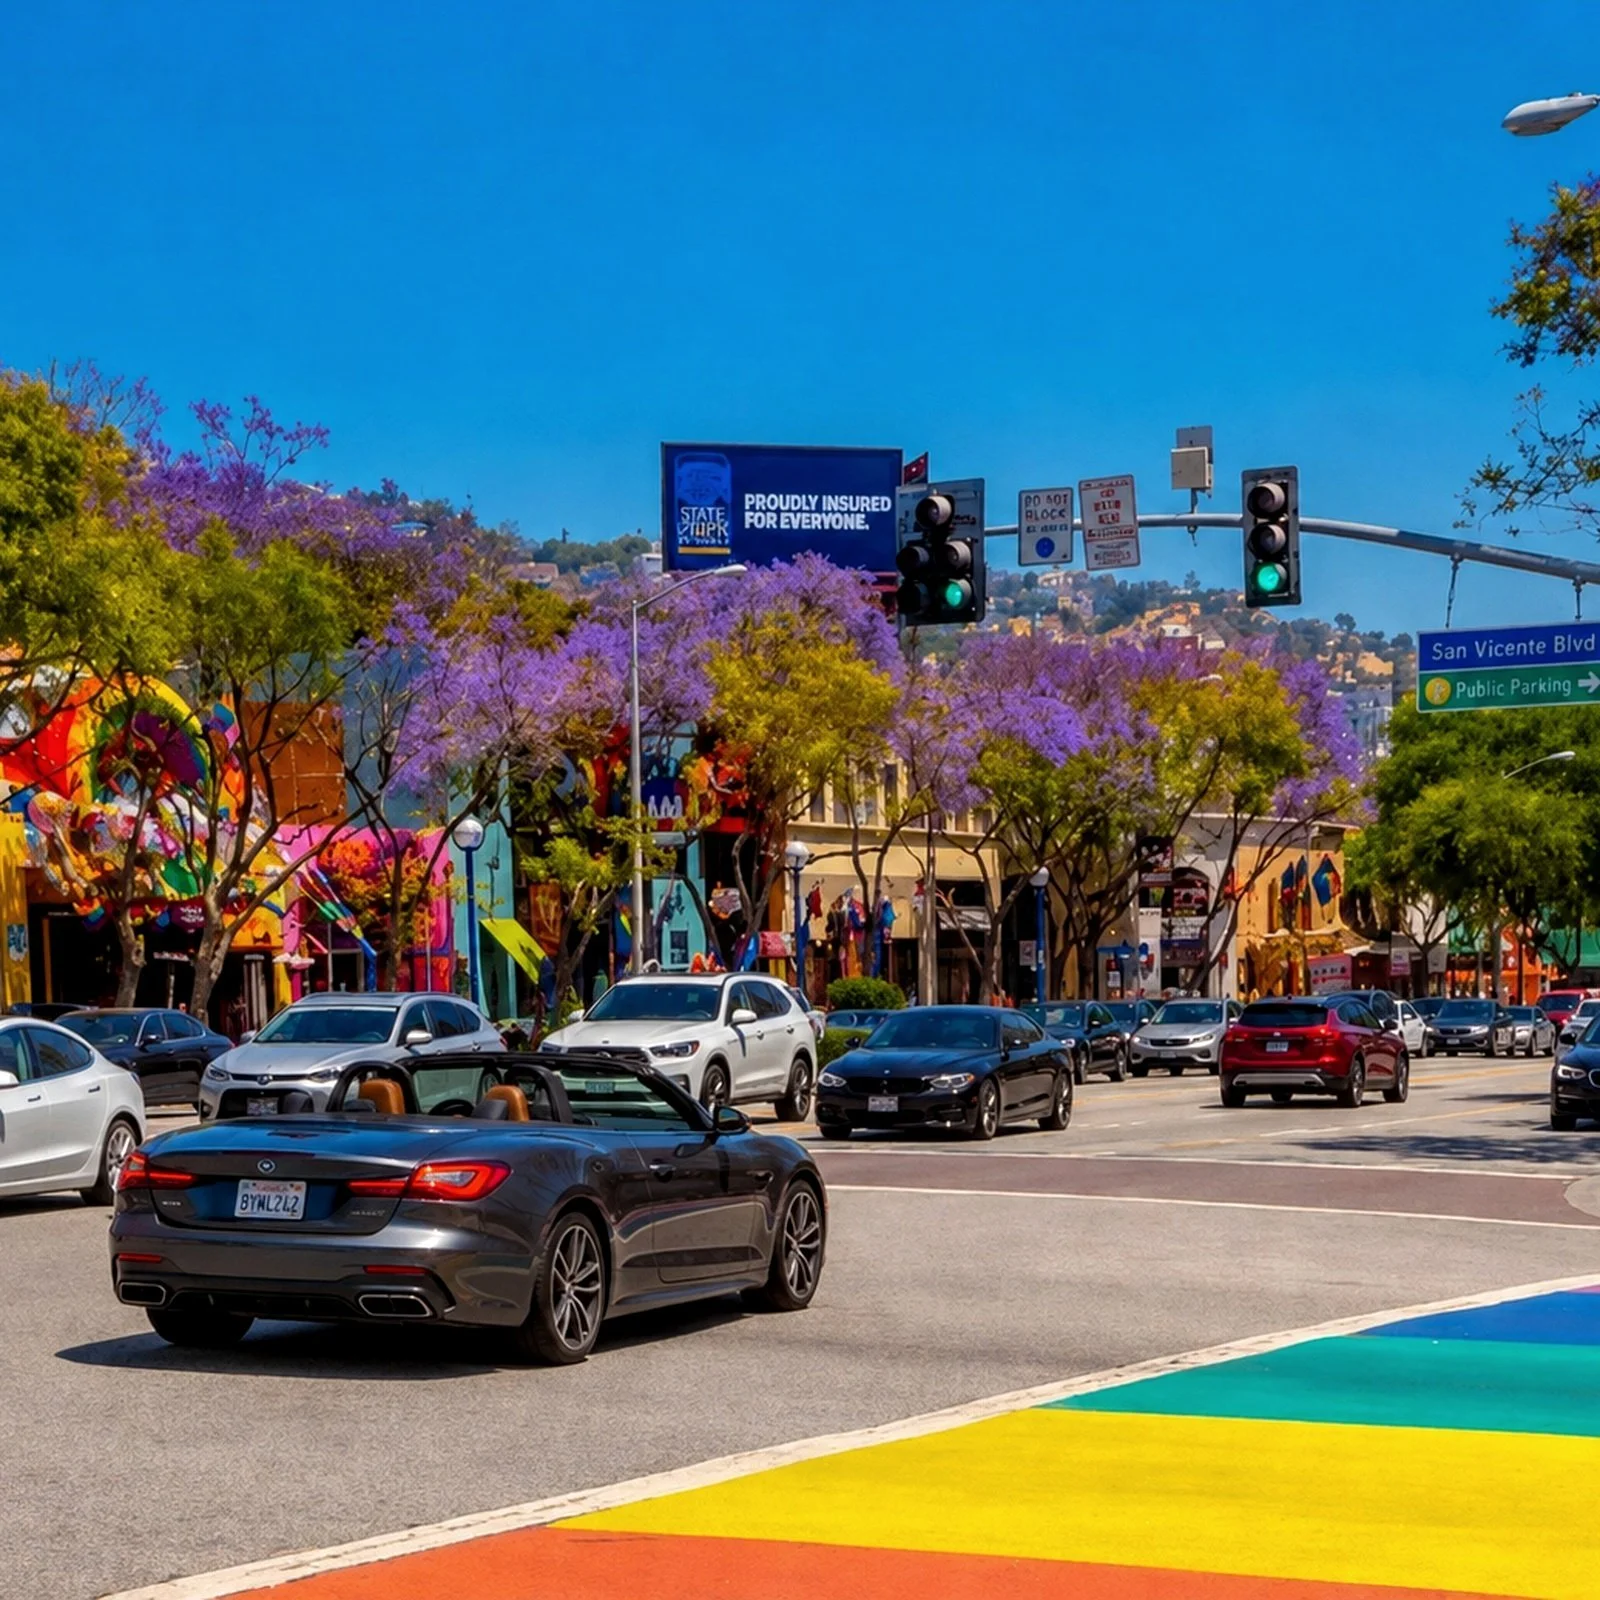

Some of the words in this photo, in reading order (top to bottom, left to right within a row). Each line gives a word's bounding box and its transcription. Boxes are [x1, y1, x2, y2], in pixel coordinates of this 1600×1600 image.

[744, 493, 818, 512] PROUDLY
[821, 495, 892, 512] INSURED
[680, 506, 725, 522] STATE
[744, 511, 777, 529] FOR
[780, 512, 870, 530] EVERYONE.
[1432, 642, 1467, 660] San
[1474, 638, 1547, 658] Vicente
[1553, 632, 1596, 654] Blvd
[1455, 679, 1505, 699] Public
[1510, 676, 1572, 697] Parking
